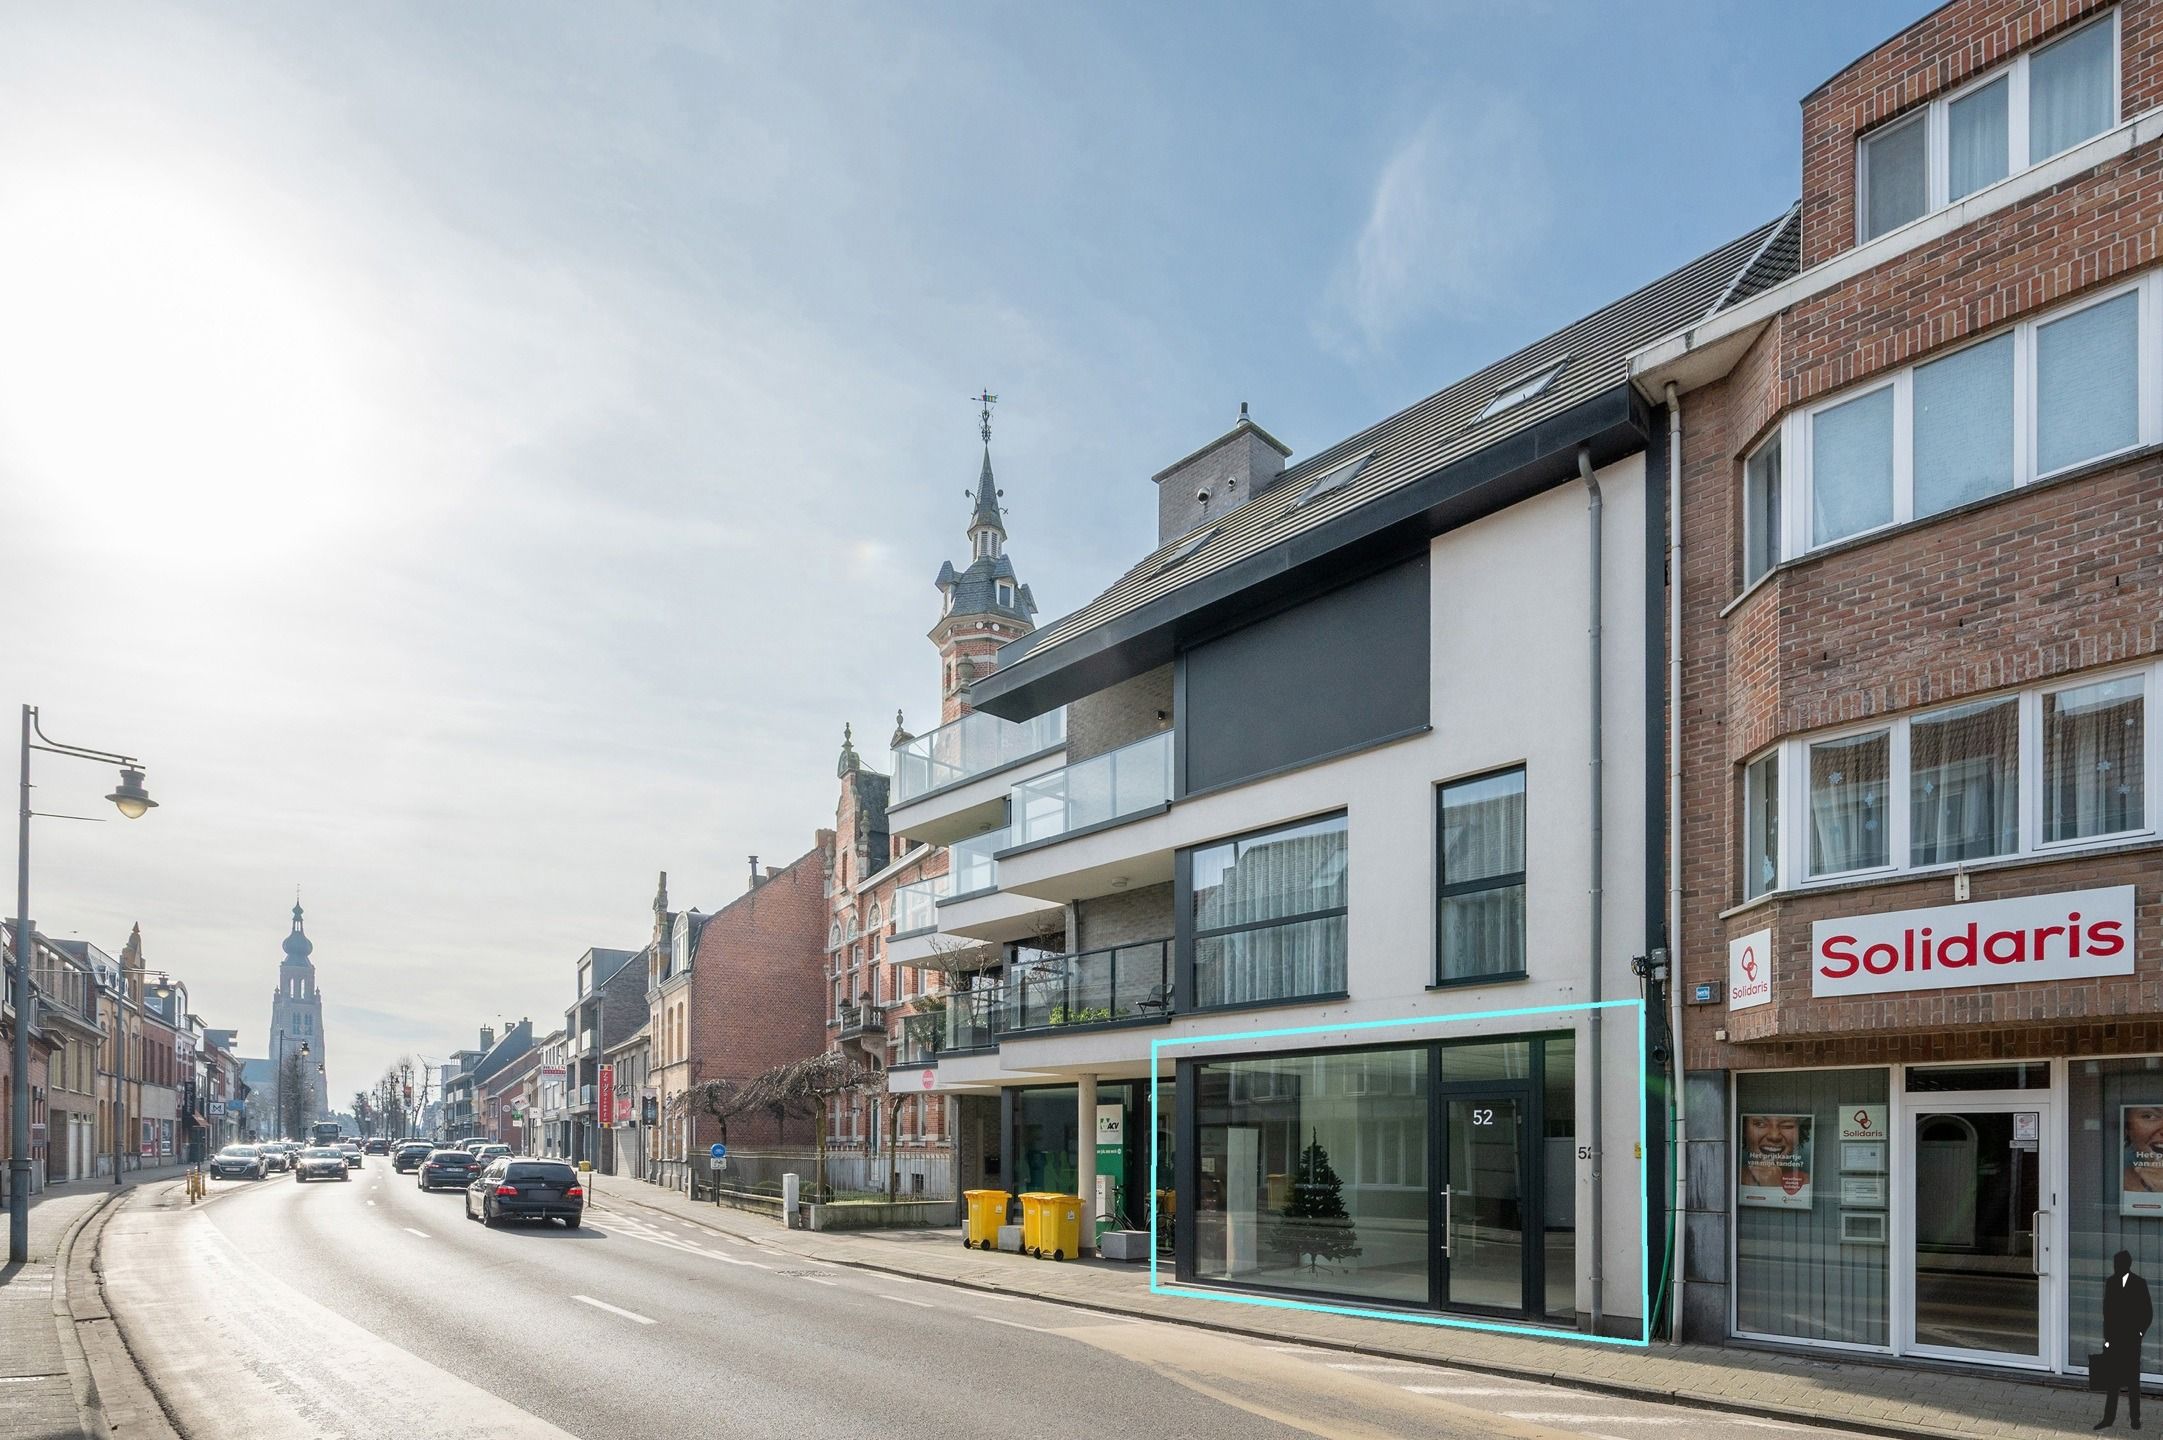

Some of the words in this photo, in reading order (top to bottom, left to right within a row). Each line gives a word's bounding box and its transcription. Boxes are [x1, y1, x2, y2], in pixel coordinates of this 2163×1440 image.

[1819, 911, 2125, 979] Solidaris
[1732, 981, 1768, 1000] Solidaris
[1472, 1109, 1494, 1126] 52
[1107, 1122, 1120, 1130] ACV
[1843, 1129, 1883, 1138] Solidaris
[1763, 1153, 1802, 1162] prijskaartje
[2136, 1151, 2154, 1159] Het
[1776, 1160, 1804, 1168] tanden?
